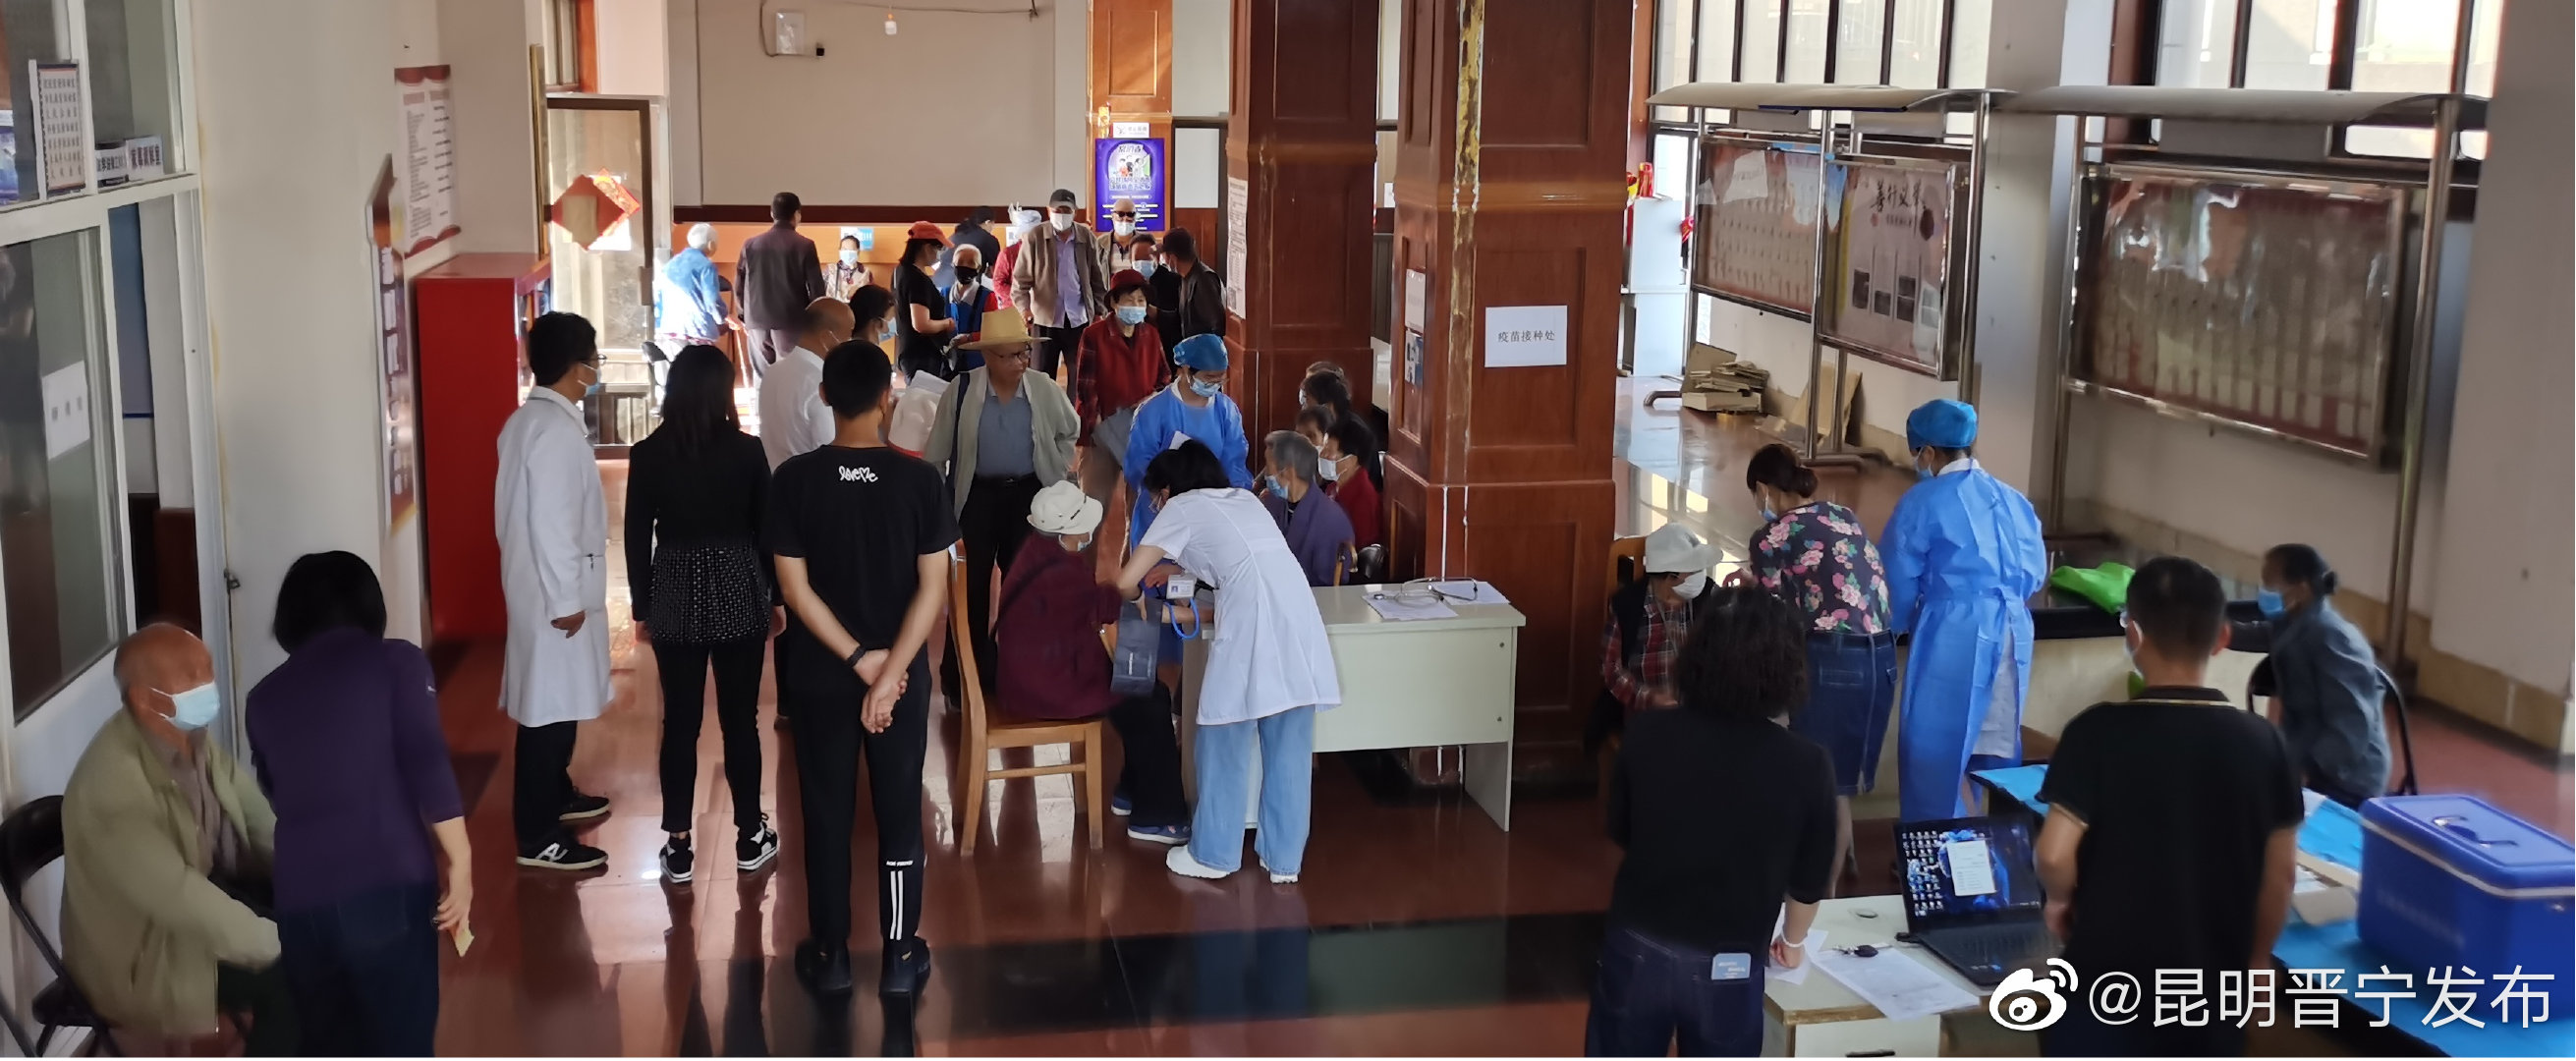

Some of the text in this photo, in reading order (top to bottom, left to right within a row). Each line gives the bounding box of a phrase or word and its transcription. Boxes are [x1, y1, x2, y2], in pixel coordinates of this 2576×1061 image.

[1497, 329, 1556, 343] 疫苗接种处
